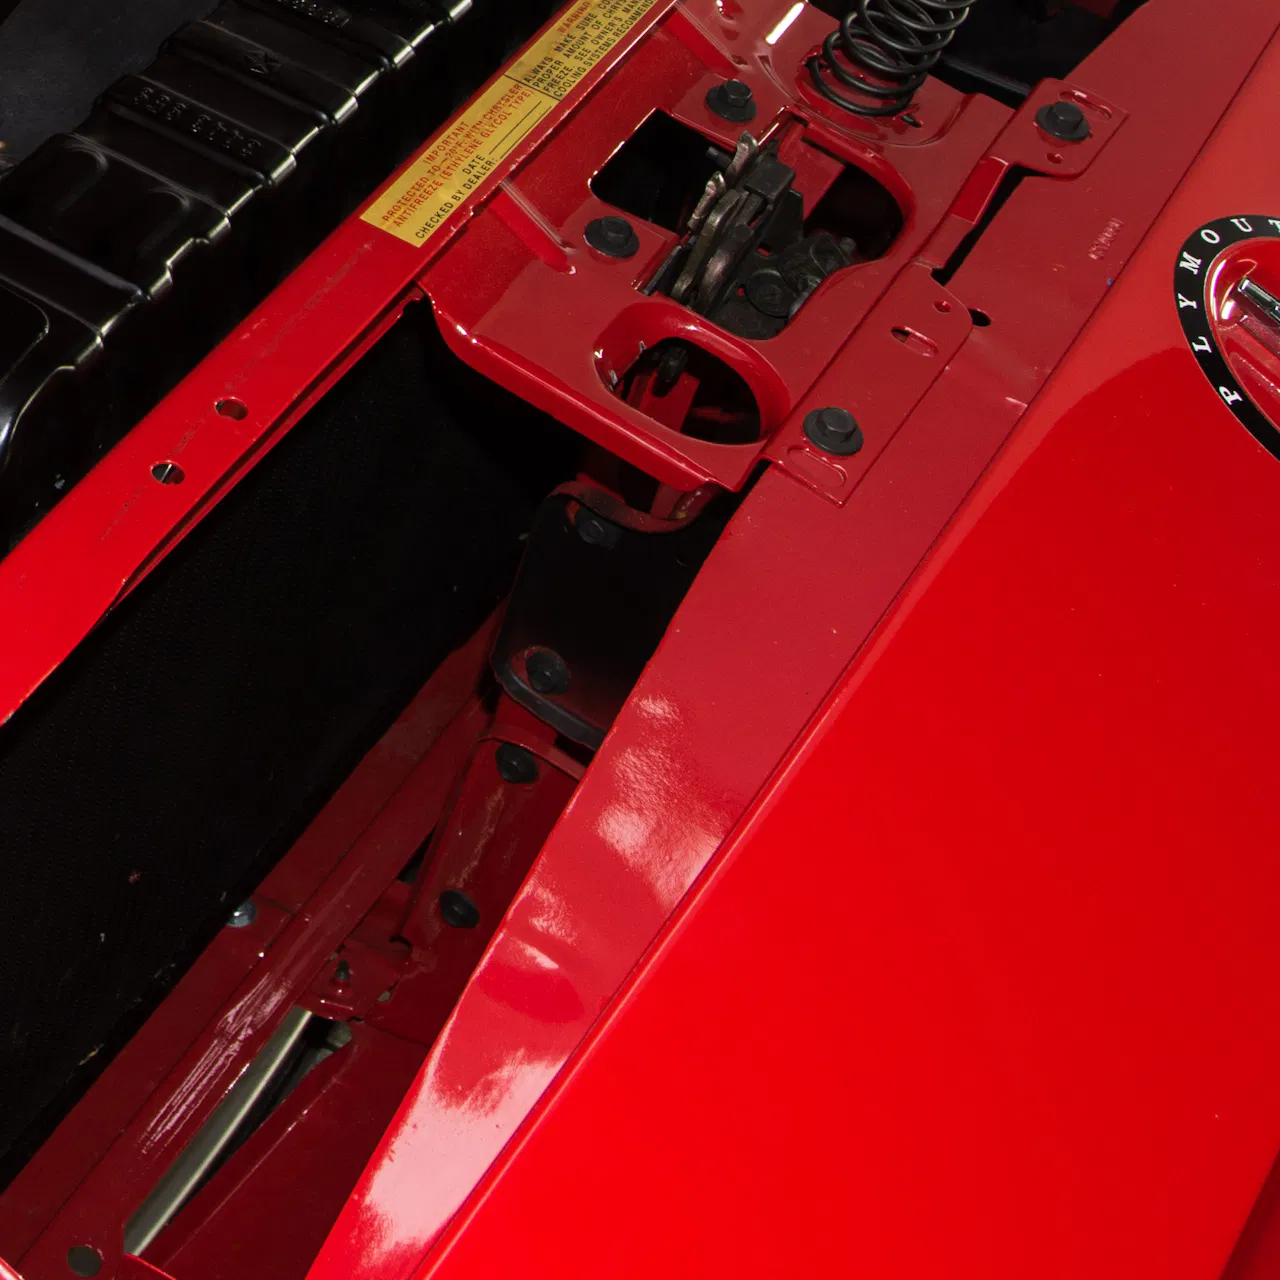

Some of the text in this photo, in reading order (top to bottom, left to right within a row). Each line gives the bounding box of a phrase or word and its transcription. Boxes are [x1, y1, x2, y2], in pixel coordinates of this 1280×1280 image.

[556, 1, 591, 34] WARNING
[574, 46, 592, 62] SEE
[591, 16, 623, 45] OWNER'S
[523, 56, 553, 83] ALWAYS
[554, 33, 576, 53] MAKE
[576, 12, 598, 31] SURE
[532, 60, 564, 88] PROPER
[563, 31, 592, 59] AMOUNT
[591, 19, 604, 31] OF
[553, 66, 587, 98] COOLING
[583, 37, 616, 67] SYSTEMS
[382, 176, 429, 222] PROTECTED
[427, 165, 441, 177] TO
[463, 120, 484, 143] WITH
[483, 83, 522, 122] CHRYSLER
[393, 88, 535, 227] ANTIFREEZE (ETHYLENE GLYCOL TYPE)
[423, 121, 470, 165] IMPORTANT
[462, 154, 486, 175] DATE
[415, 202, 454, 239] CHECKED
[452, 189, 465, 202] BY
